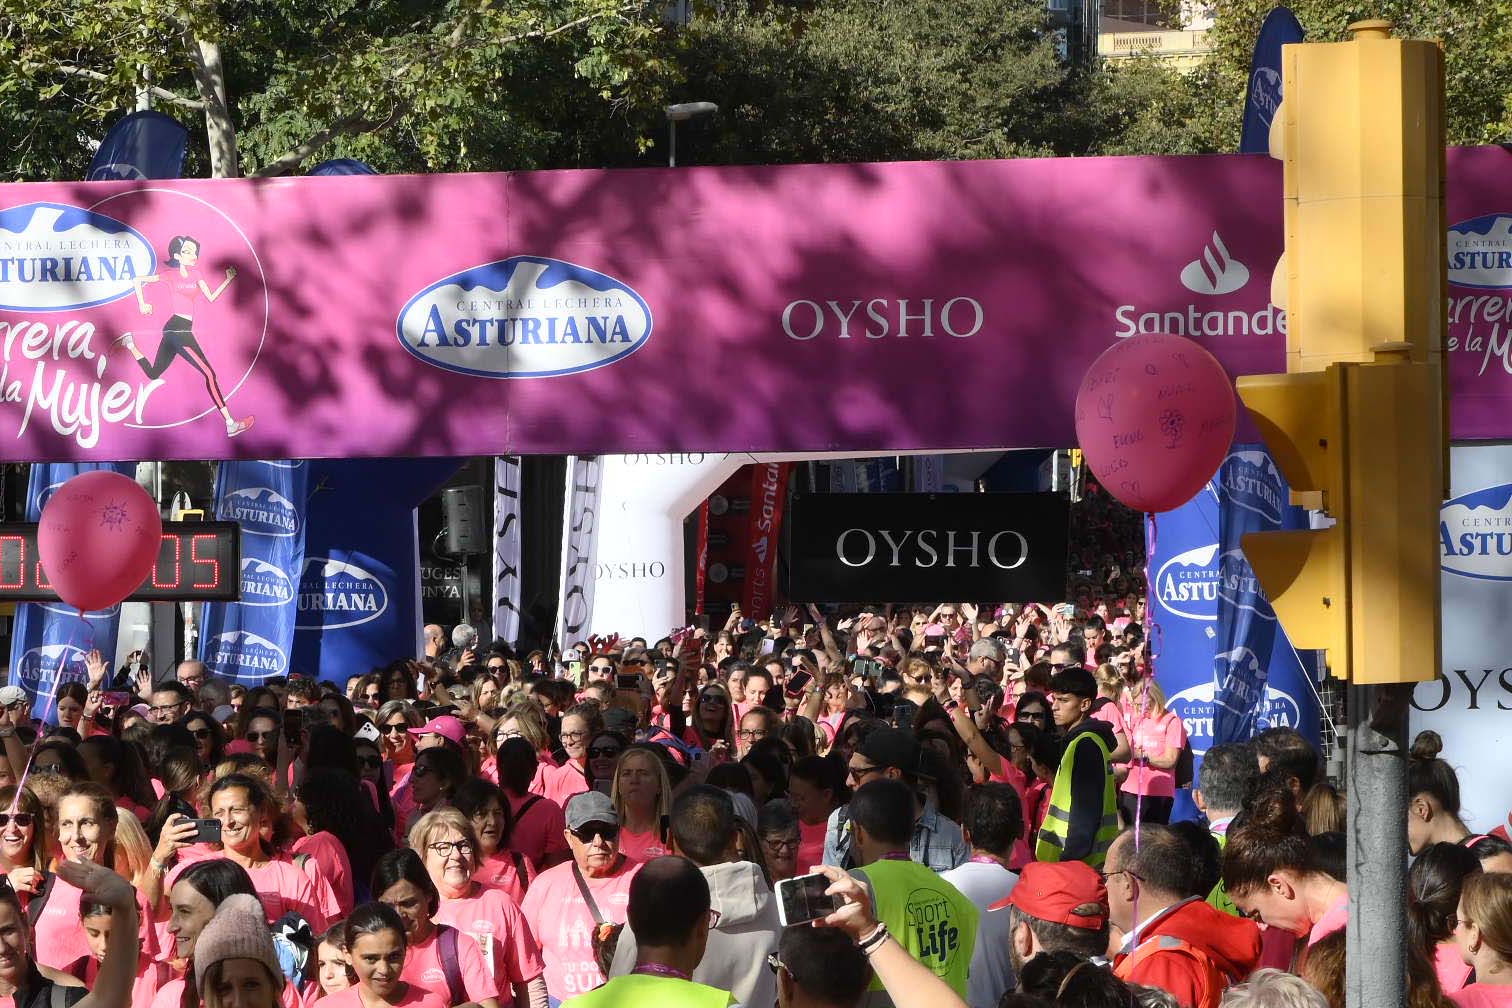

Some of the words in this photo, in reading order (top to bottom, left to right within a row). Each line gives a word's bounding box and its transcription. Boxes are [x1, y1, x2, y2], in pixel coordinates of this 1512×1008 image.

[59, 239, 132, 250] LECHERA
[456, 298, 534, 312] CENTRAL
[543, 296, 623, 309] LECHERA
[417, 303, 633, 348] ASTURIANA
[781, 296, 985, 342] OYSHO
[1115, 303, 1288, 338] Santande
[16, 354, 165, 448] Mujer
[224, 502, 296, 531] ASTURIANA
[565, 457, 597, 634] OYSH
[834, 527, 1030, 570] OYSHO
[325, 580, 375, 590] LECHERA
[422, 567, 461, 579] UGES
[1163, 573, 1219, 601] ASTU
[240, 580, 289, 600] URIANA
[297, 591, 379, 612] URIANA
[907, 898, 951, 927] Sport
[917, 920, 959, 962] Life
